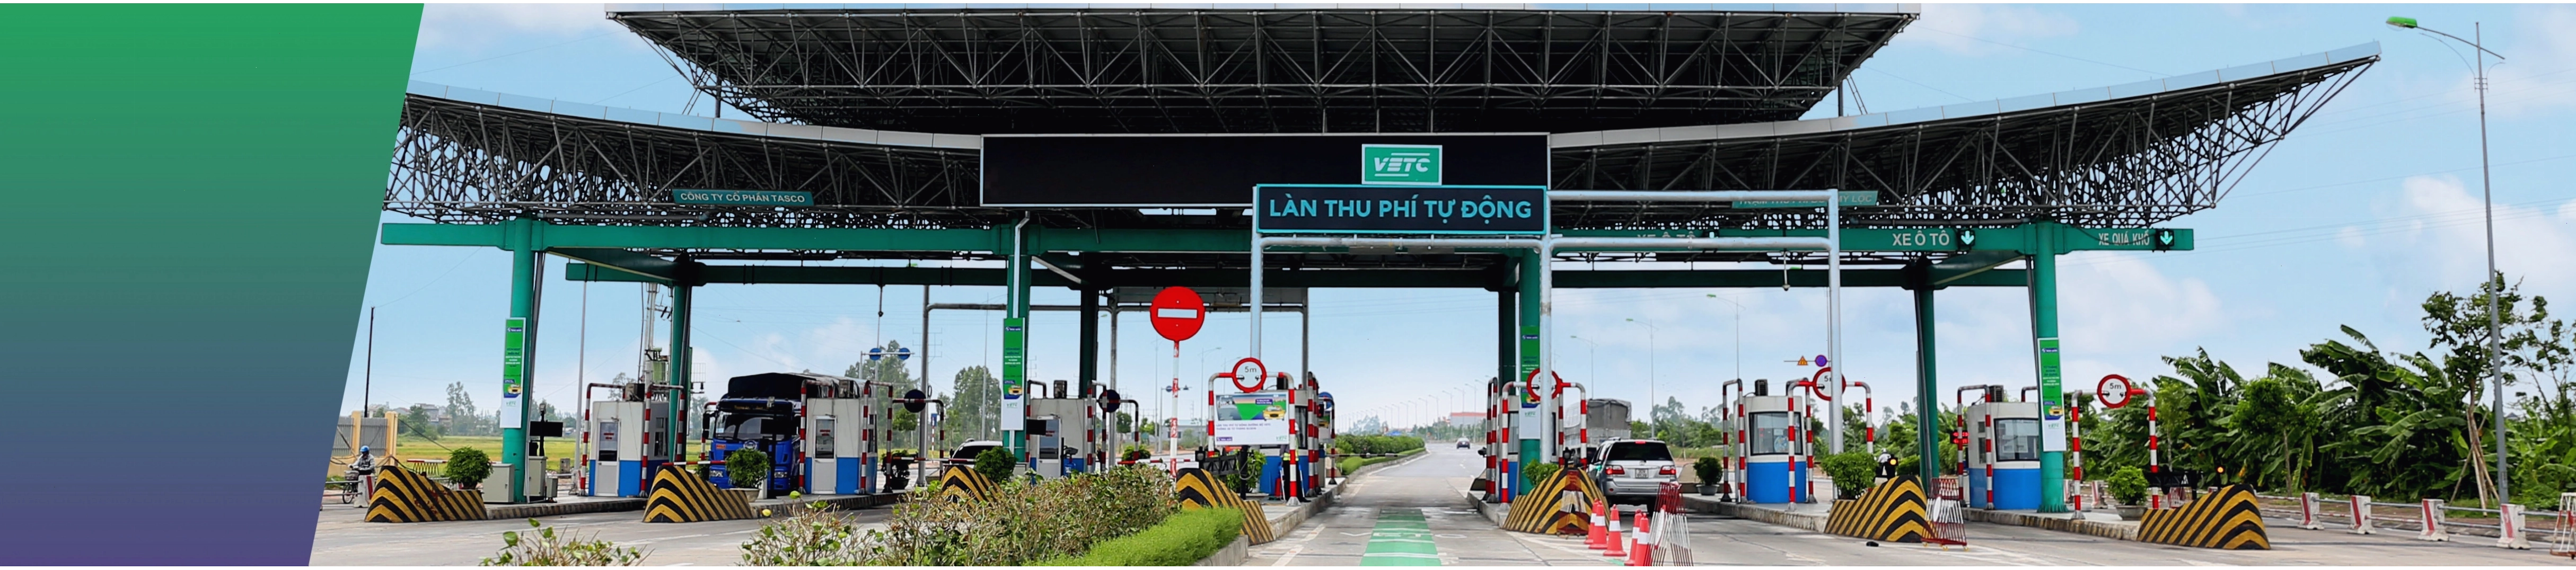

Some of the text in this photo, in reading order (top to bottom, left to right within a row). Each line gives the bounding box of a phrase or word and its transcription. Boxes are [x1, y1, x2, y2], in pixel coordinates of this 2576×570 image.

[1374, 157, 1430, 172] VETC
[681, 191, 709, 201] CÔNG
[1270, 193, 1531, 224] LÀN THU PHÍ TỰ ĐỘNG
[1892, 230, 1950, 246] XE Ô TÔ
[2098, 233, 2109, 245] XE
[2112, 230, 2130, 246] QUÁ
